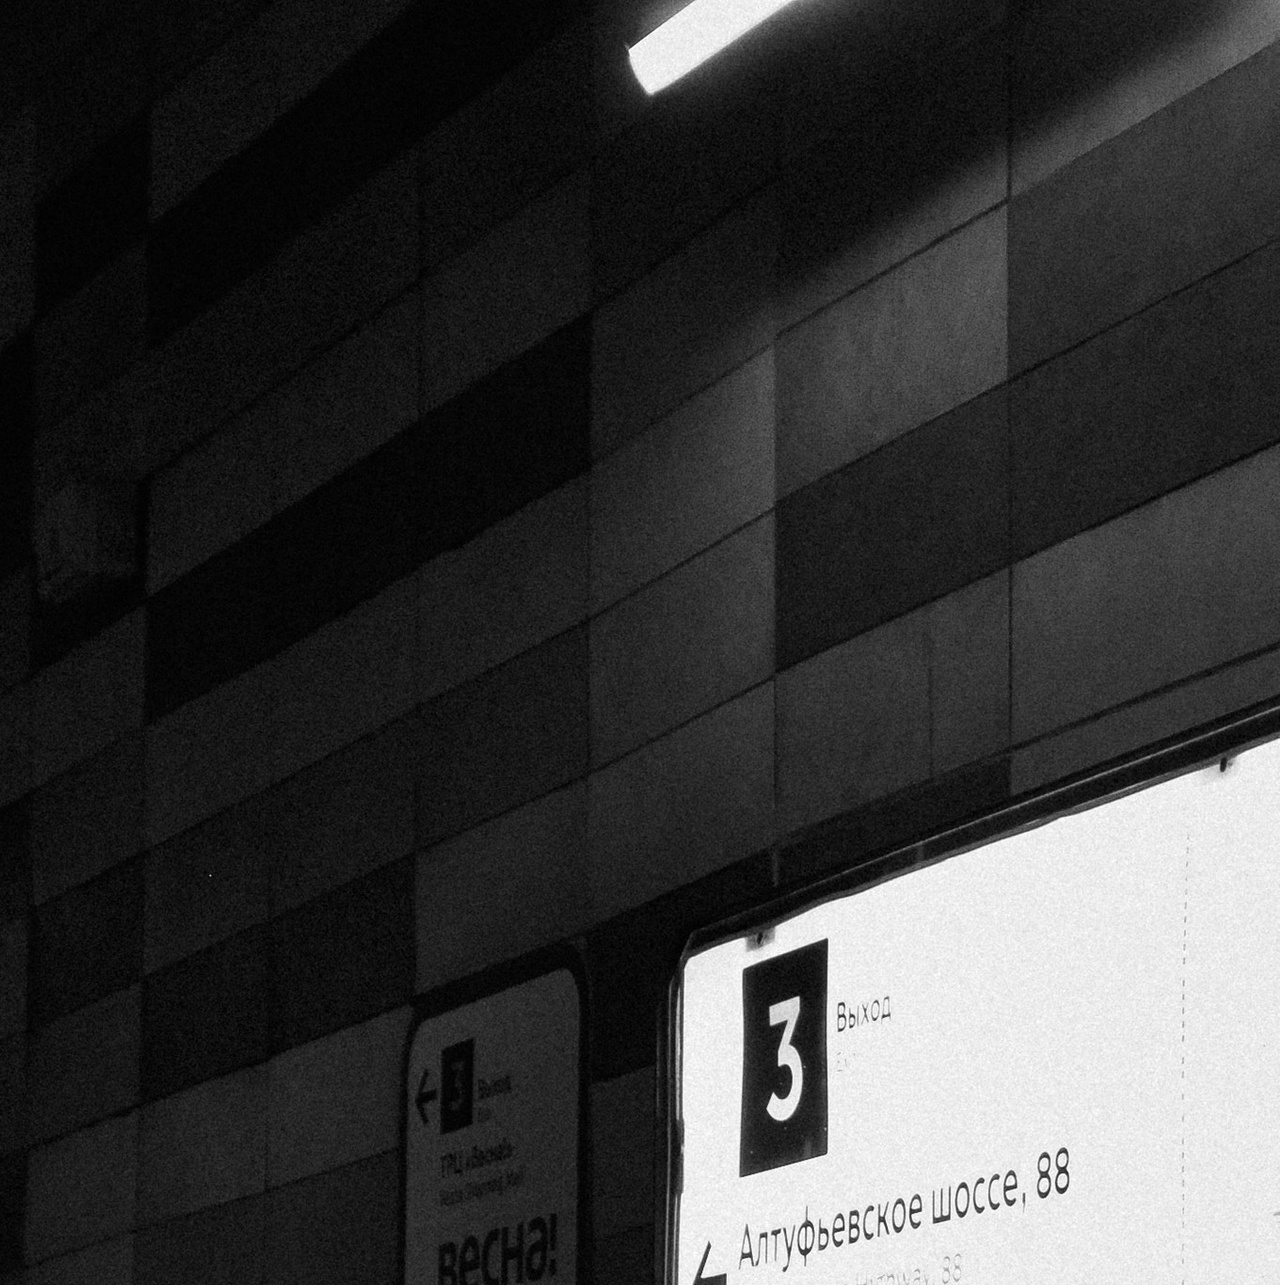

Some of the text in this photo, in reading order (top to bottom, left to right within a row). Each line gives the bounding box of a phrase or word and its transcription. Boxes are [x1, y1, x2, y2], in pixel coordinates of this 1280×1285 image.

[836, 995, 892, 1033] Выход
[765, 995, 804, 1123] 3
[737, 1146, 1072, 1272] Алтуфьевское шоссе, 88
[941, 1252, 962, 1285] 88
